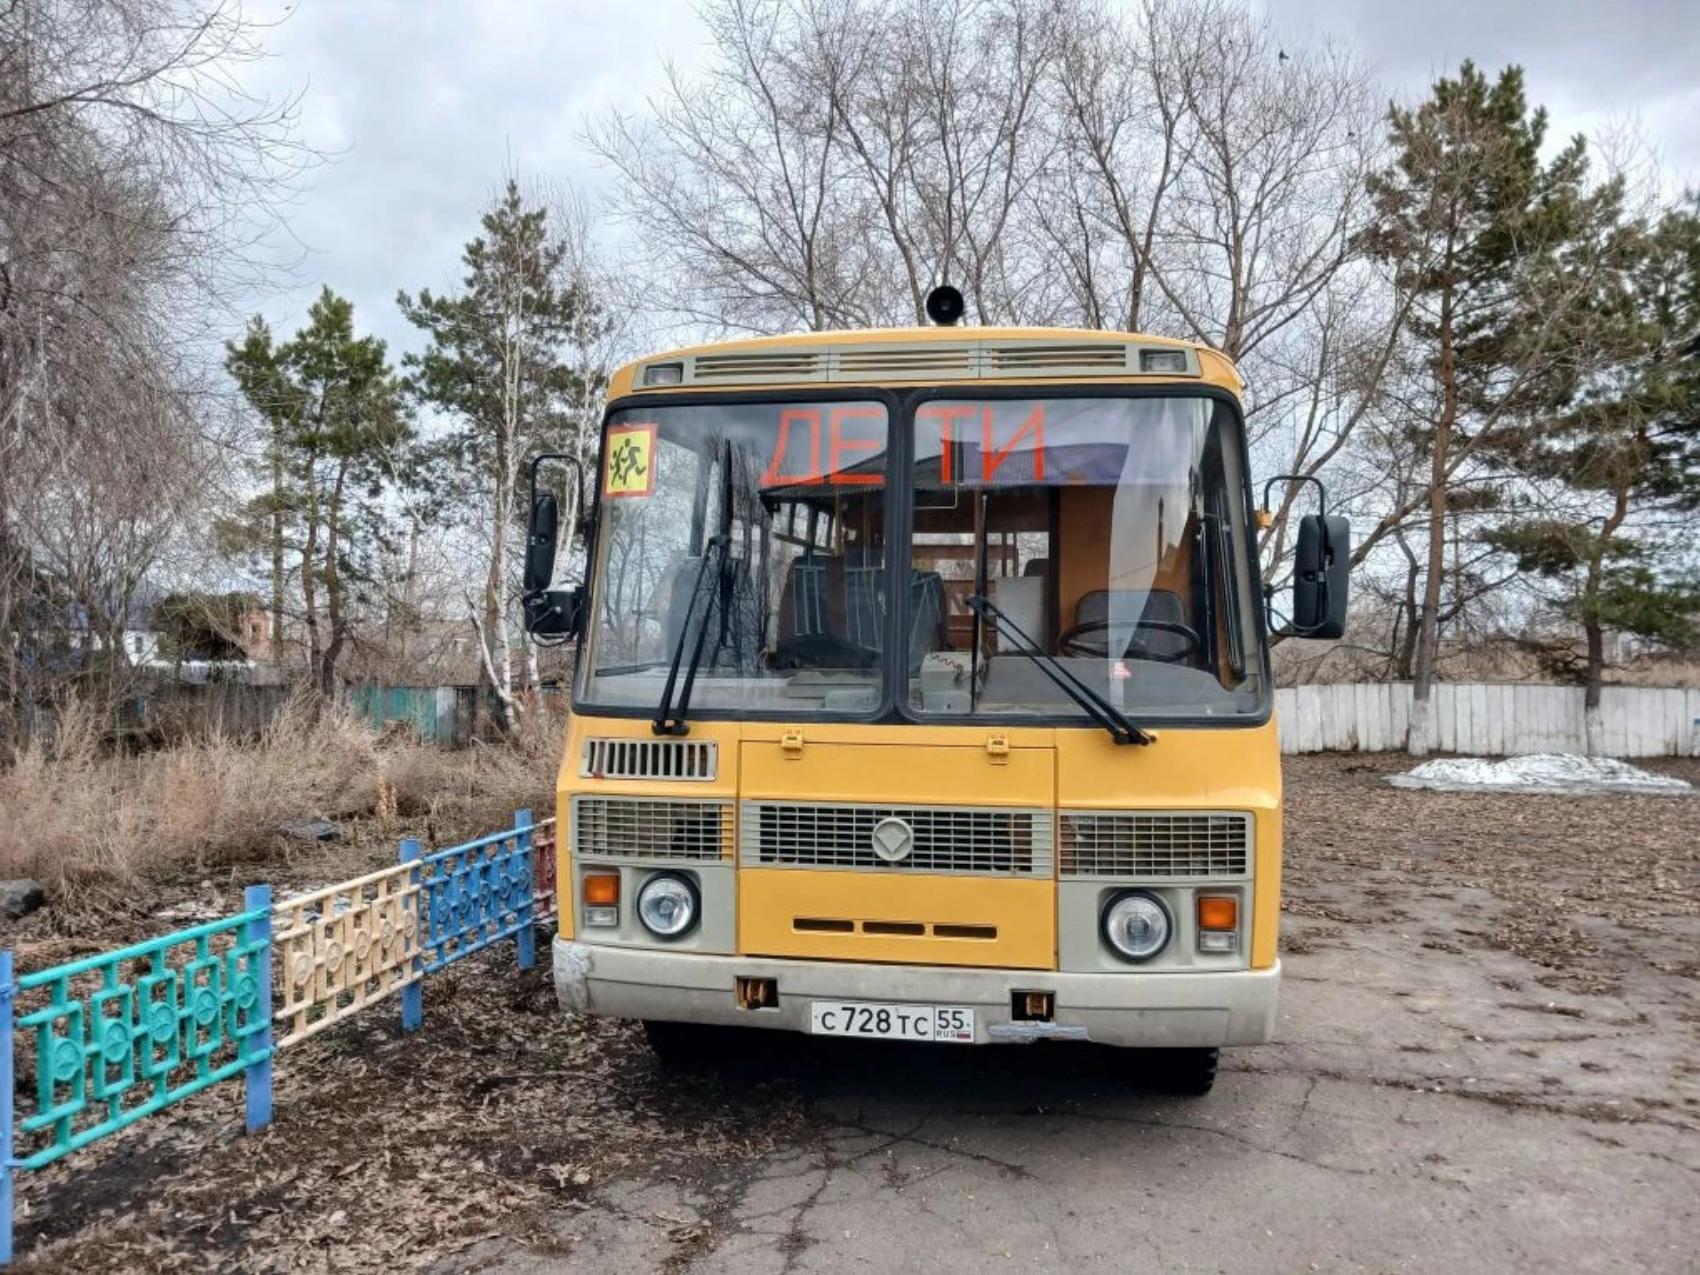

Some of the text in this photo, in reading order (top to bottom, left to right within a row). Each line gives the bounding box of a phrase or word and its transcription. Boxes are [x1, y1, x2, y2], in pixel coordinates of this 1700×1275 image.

[760, 401, 1045, 486] ДЕТИ
[937, 1010, 965, 1030] 55
[936, 1030, 957, 1039] RUS
